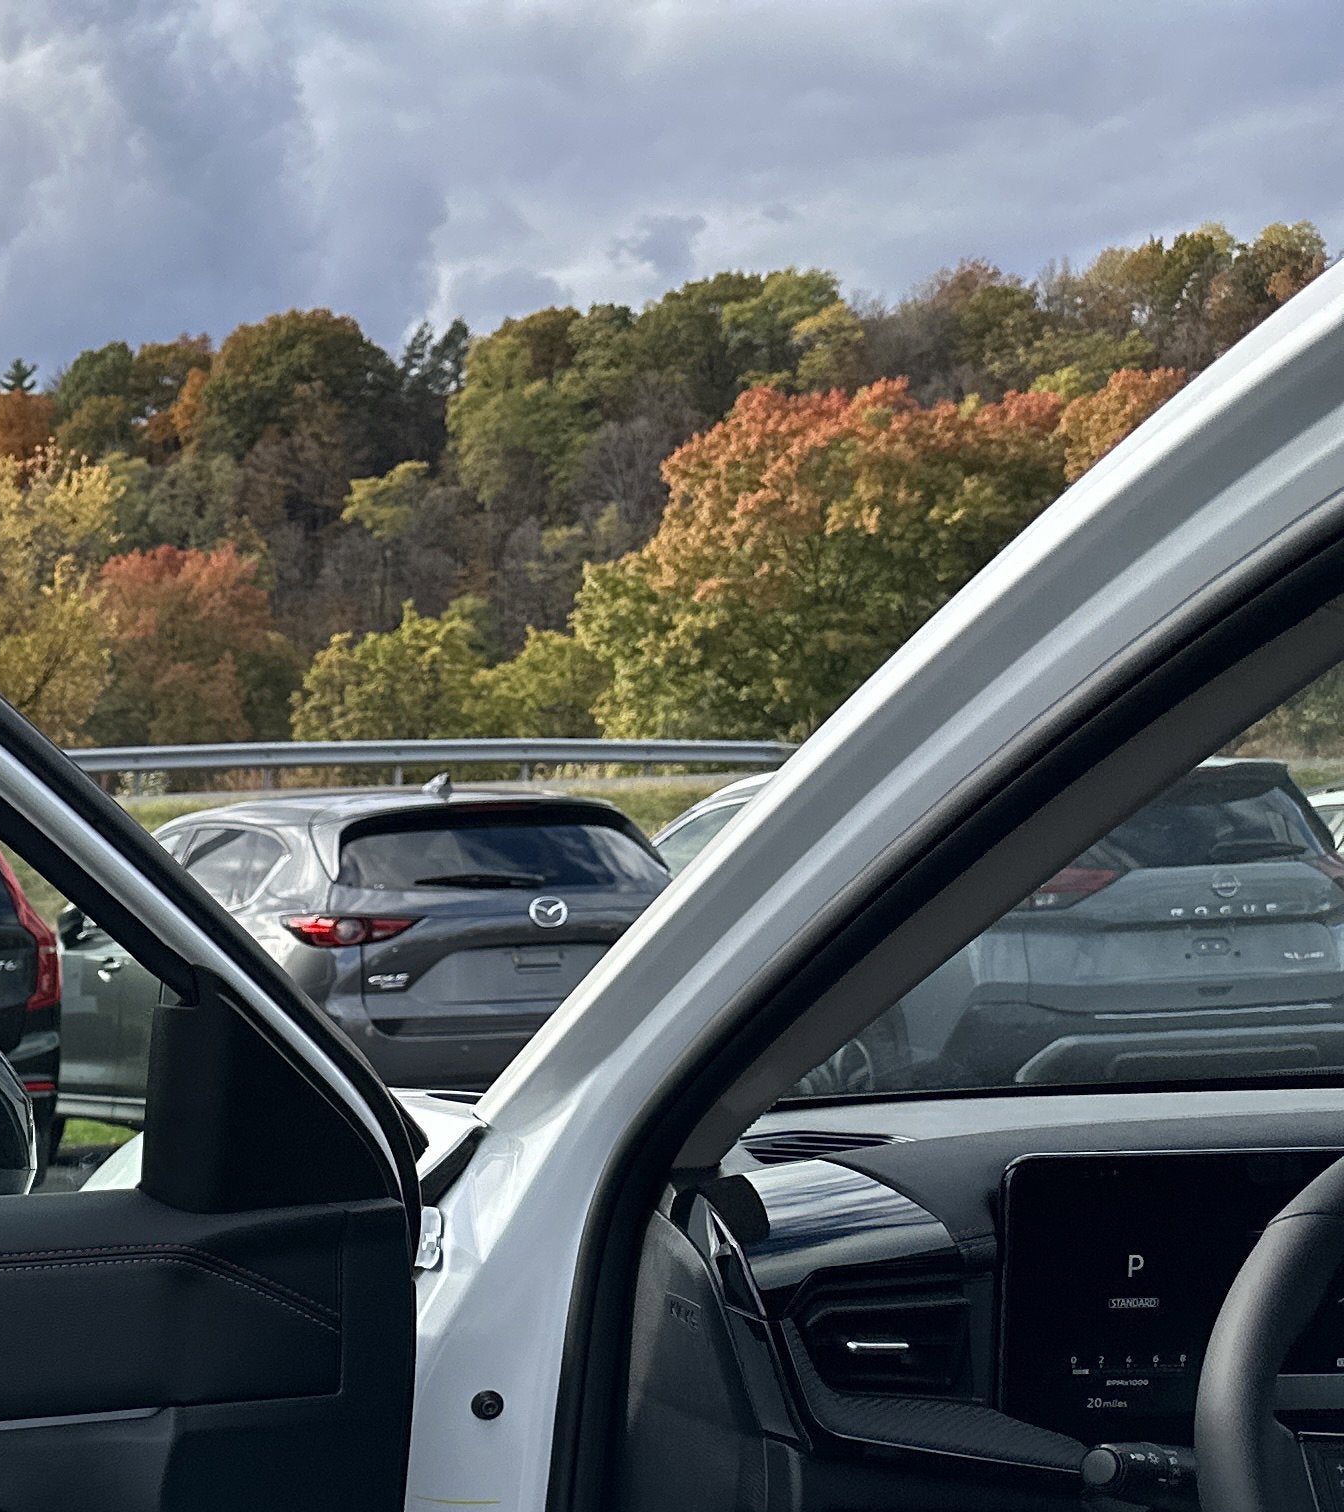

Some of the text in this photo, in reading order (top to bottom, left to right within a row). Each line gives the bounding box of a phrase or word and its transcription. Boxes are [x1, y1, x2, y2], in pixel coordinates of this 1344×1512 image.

[1170, 903, 1279, 917] ROGUE
[1127, 1254, 1145, 1278] P
[1111, 1298, 1158, 1308] STANDARD
[1070, 1356, 1078, 1365] 0
[1098, 1356, 1105, 1364] 2
[1125, 1355, 1132, 1363] 4
[1152, 1354, 1160, 1363] 6
[1086, 1397, 1128, 1409] 20 miles
